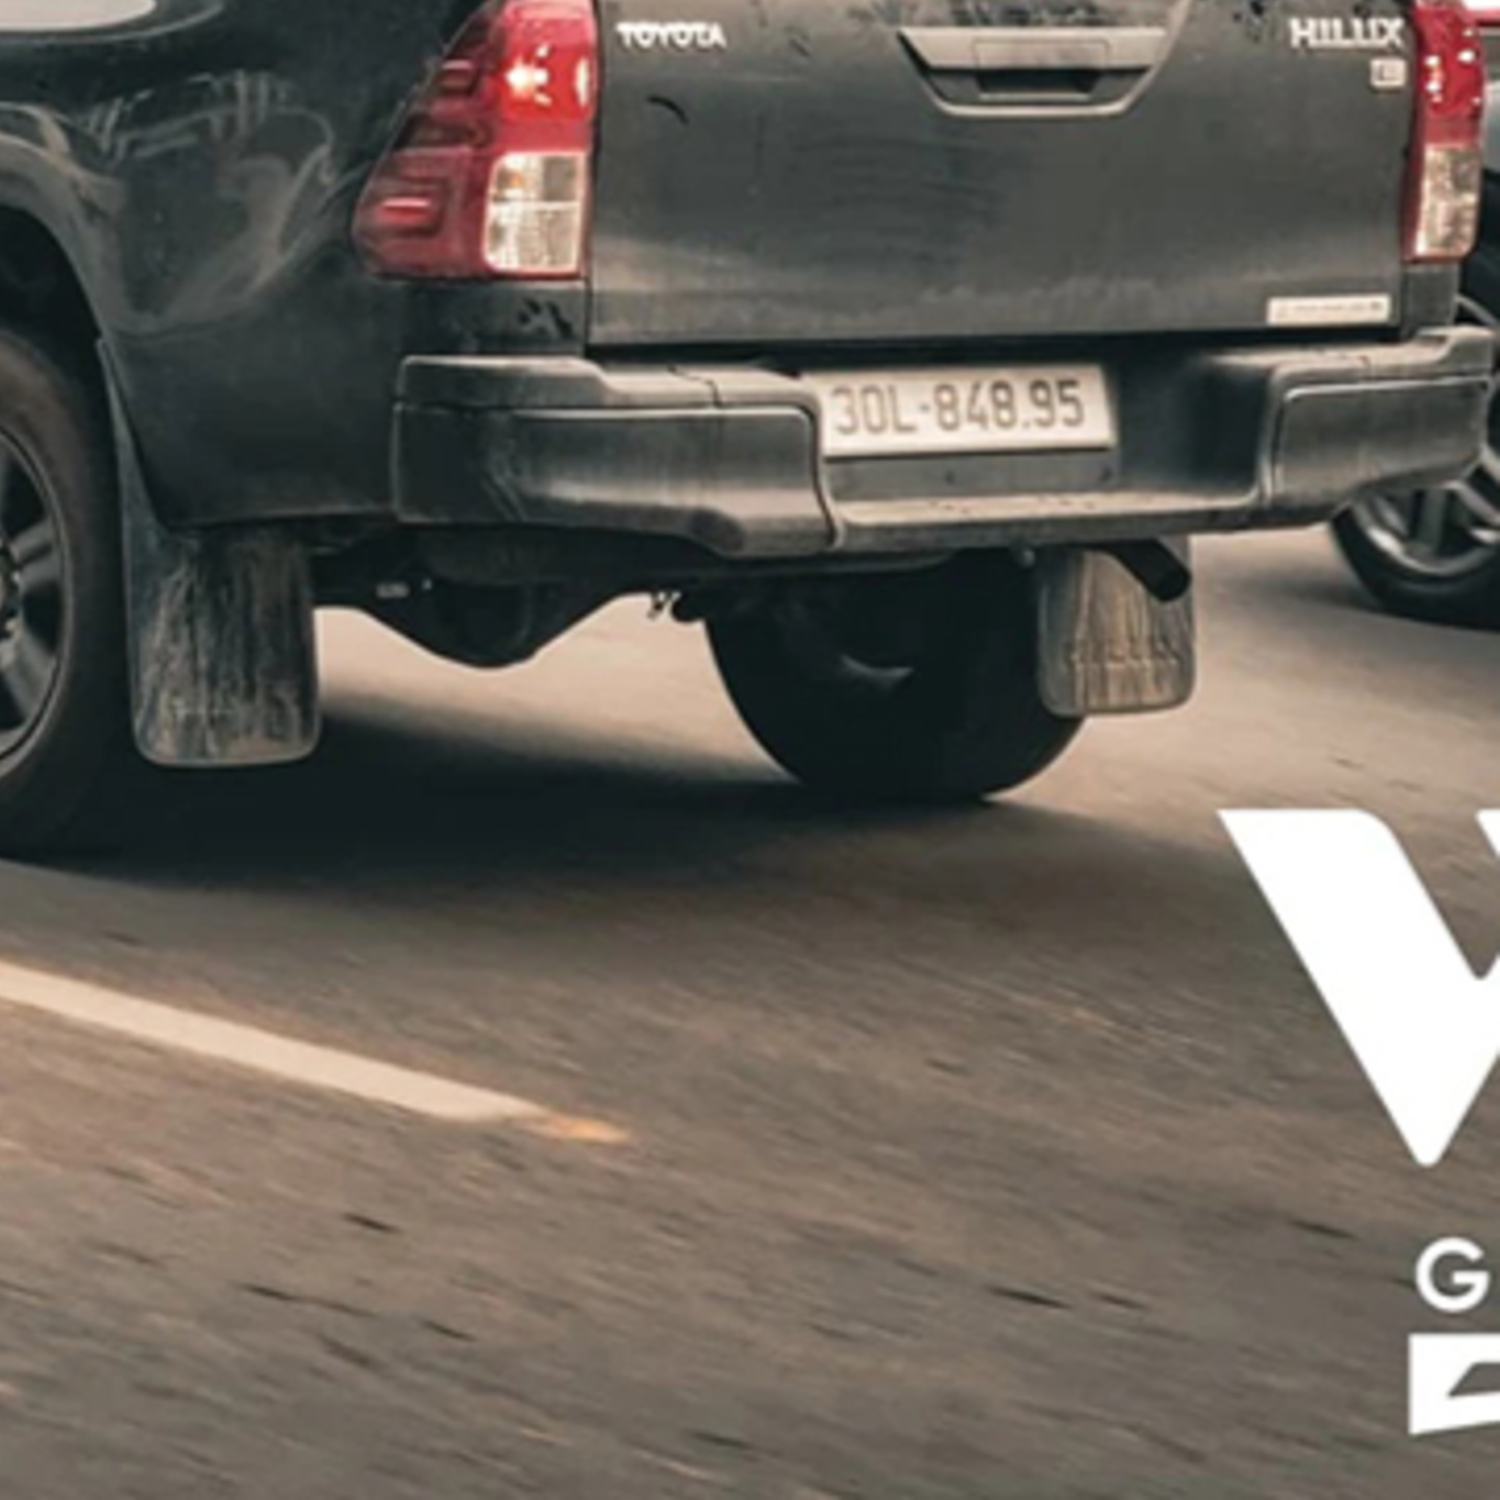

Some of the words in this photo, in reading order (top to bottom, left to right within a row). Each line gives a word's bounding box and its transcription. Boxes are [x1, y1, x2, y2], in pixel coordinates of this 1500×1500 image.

[617, 22, 727, 49] TOYOTA
[1288, 16, 1405, 49] HILUX
[831, 378, 1085, 436] 30L-848.95
